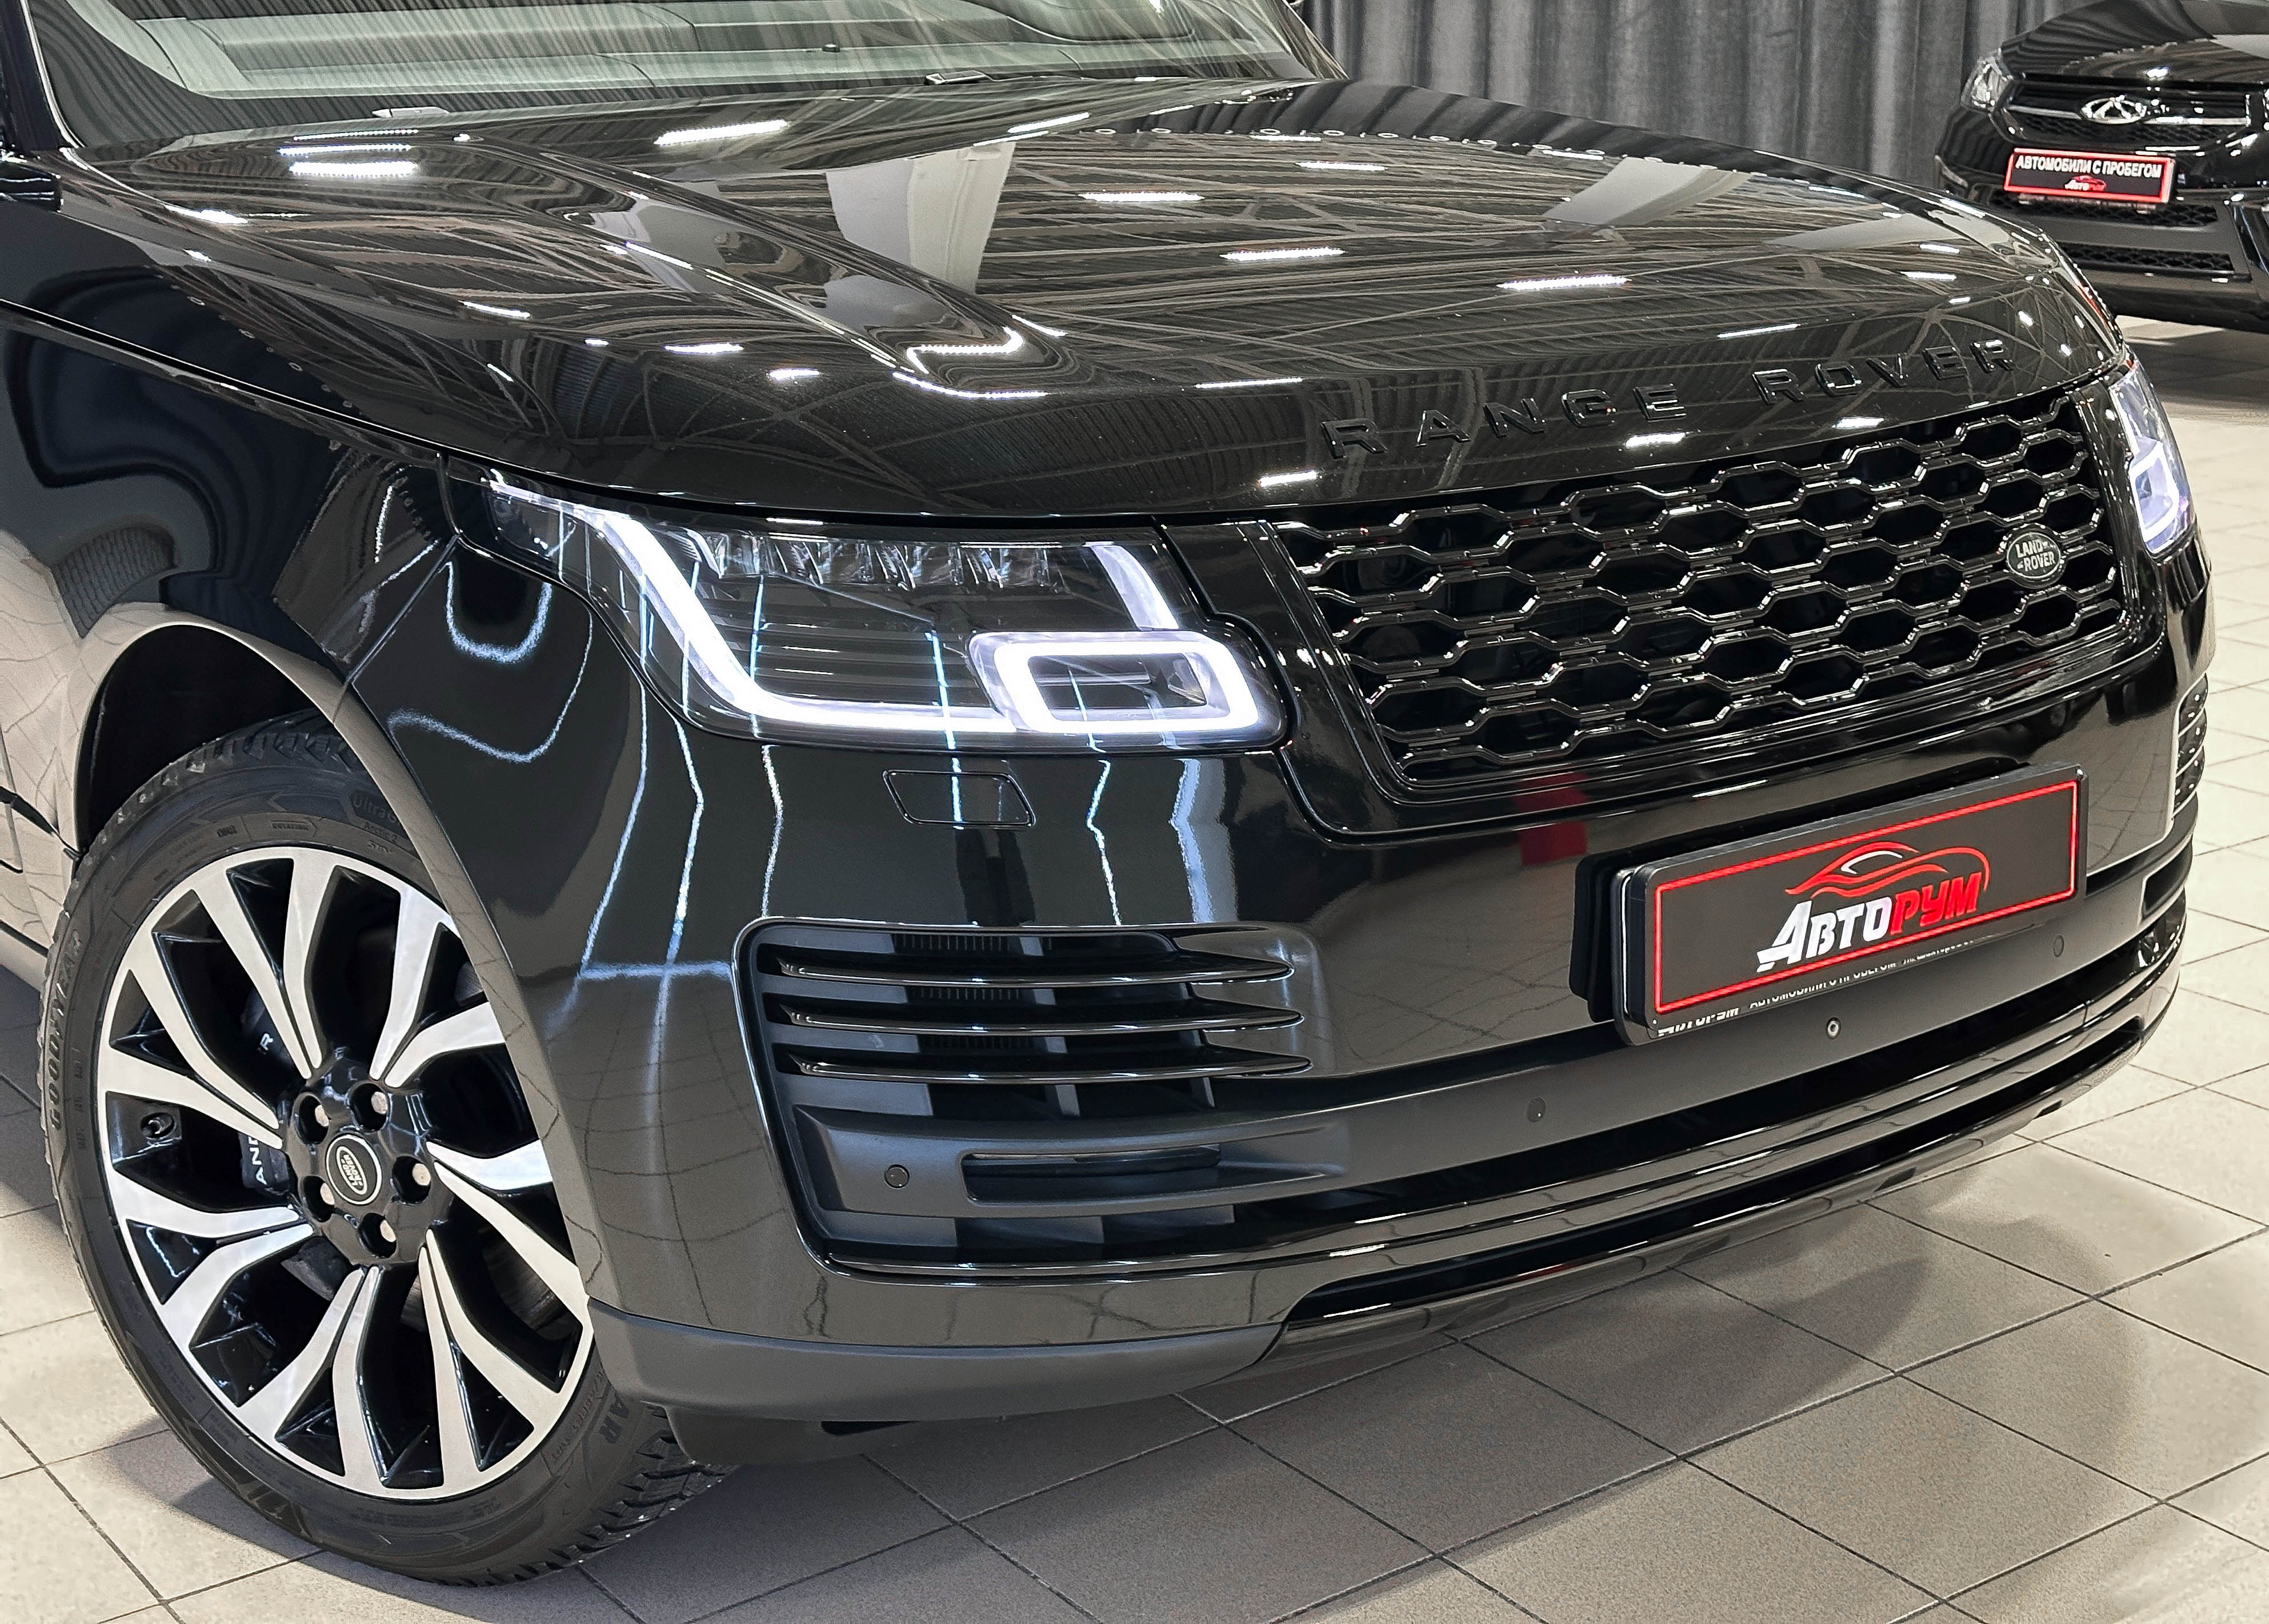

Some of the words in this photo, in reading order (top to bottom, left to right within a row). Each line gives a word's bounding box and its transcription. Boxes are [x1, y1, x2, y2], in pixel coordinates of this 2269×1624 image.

[2015, 155, 2091, 173] АВТОМОБИЛИ
[2092, 161, 2101, 174] С
[2102, 161, 2162, 178] ПРОБЕГОМ
[1321, 383, 1687, 459] RANGE
[1752, 339, 2015, 406] ROVER
[2015, 539, 2043, 558] LAND
[2023, 551, 2056, 572] ROVER
[354, 795, 399, 826] UltraG
